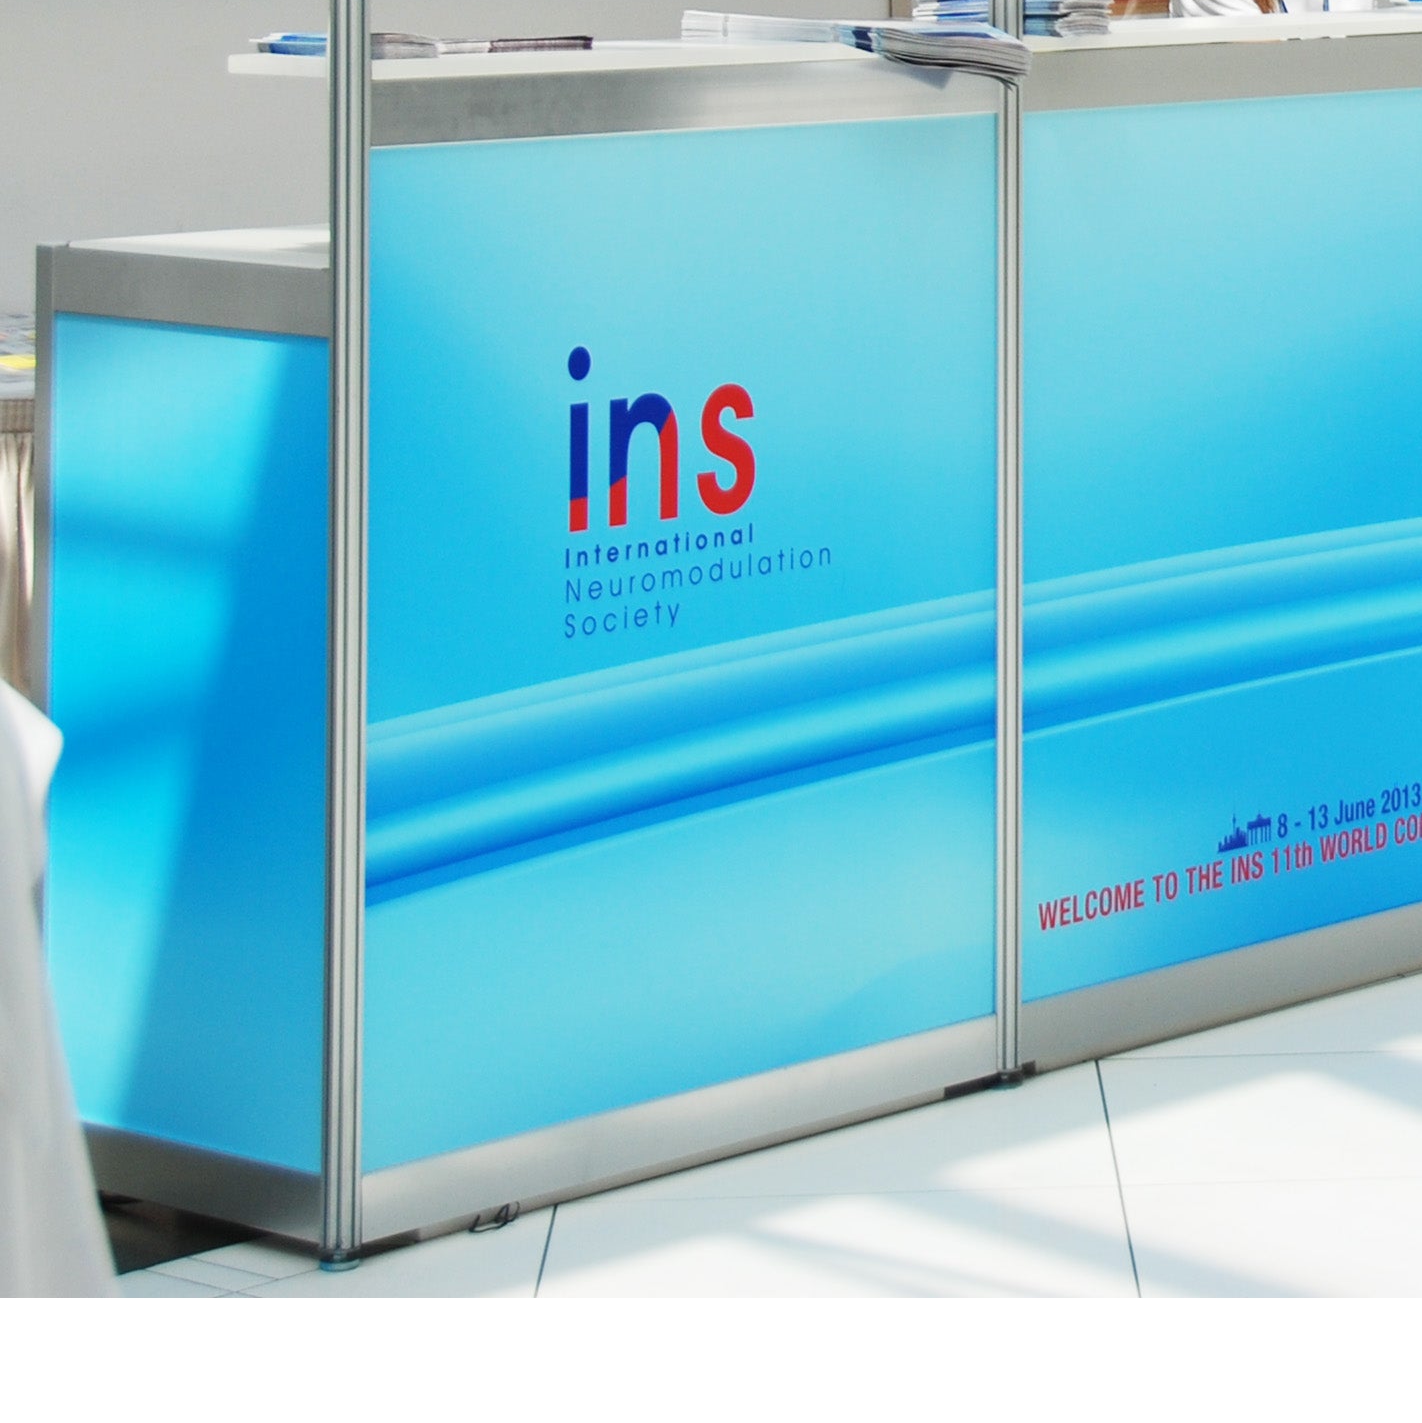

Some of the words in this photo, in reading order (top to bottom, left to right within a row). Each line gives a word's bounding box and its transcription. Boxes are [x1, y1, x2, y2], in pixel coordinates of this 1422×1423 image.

[567, 345, 757, 533] ins
[565, 522, 754, 569] International
[565, 547, 832, 604] Neuromodulation
[564, 601, 680, 639] Society
[1277, 813, 1289, 839] 8
[1308, 804, 1329, 832] 13
[1334, 797, 1376, 826] June
[1038, 879, 1146, 931] WELCOME
[1152, 871, 1178, 904] TO
[1186, 859, 1223, 894] THE
[1230, 850, 1264, 886] INS
[1272, 841, 1313, 876] 11th
[1320, 821, 1388, 864] WORLD
